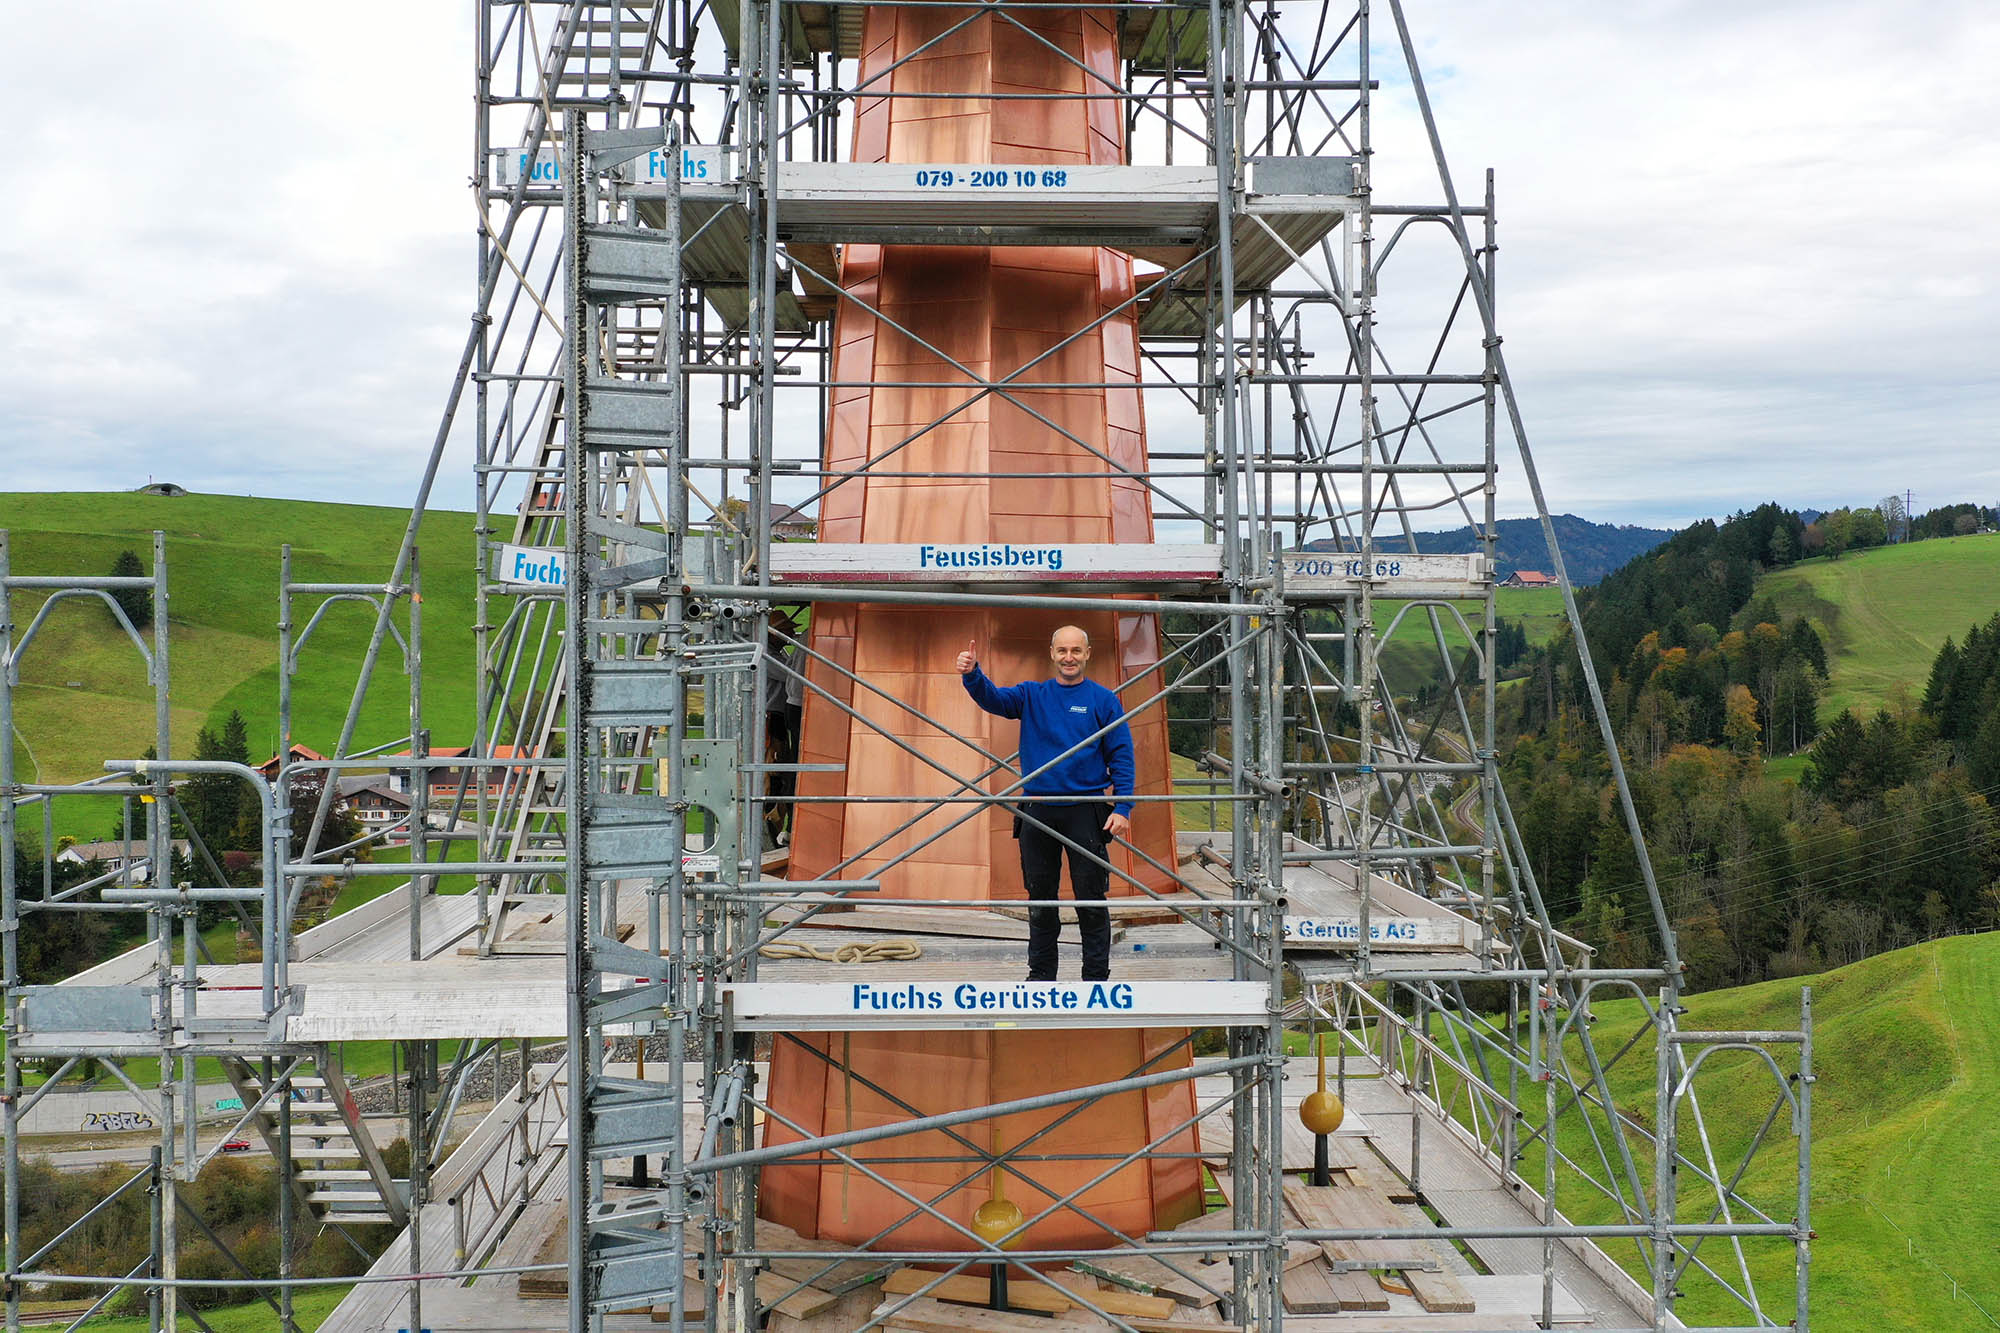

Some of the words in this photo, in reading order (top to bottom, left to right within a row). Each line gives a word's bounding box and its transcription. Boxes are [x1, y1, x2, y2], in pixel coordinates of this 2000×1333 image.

[649, 150, 707, 178] Fuhs
[916, 170, 954, 187] 079
[970, 170, 1008, 187] 200
[1014, 170, 1036, 187] 10
[1042, 170, 1067, 187] 68
[920, 545, 1063, 570] Feusisberg
[1294, 560, 1333, 576] 200
[1375, 560, 1400, 577] 68
[1299, 919, 1379, 938] Gerüse
[1386, 923, 1416, 939] AG
[853, 984, 943, 1009] Fuchs
[954, 984, 1078, 1009] Gerüste
[1086, 983, 1133, 1009] AG
